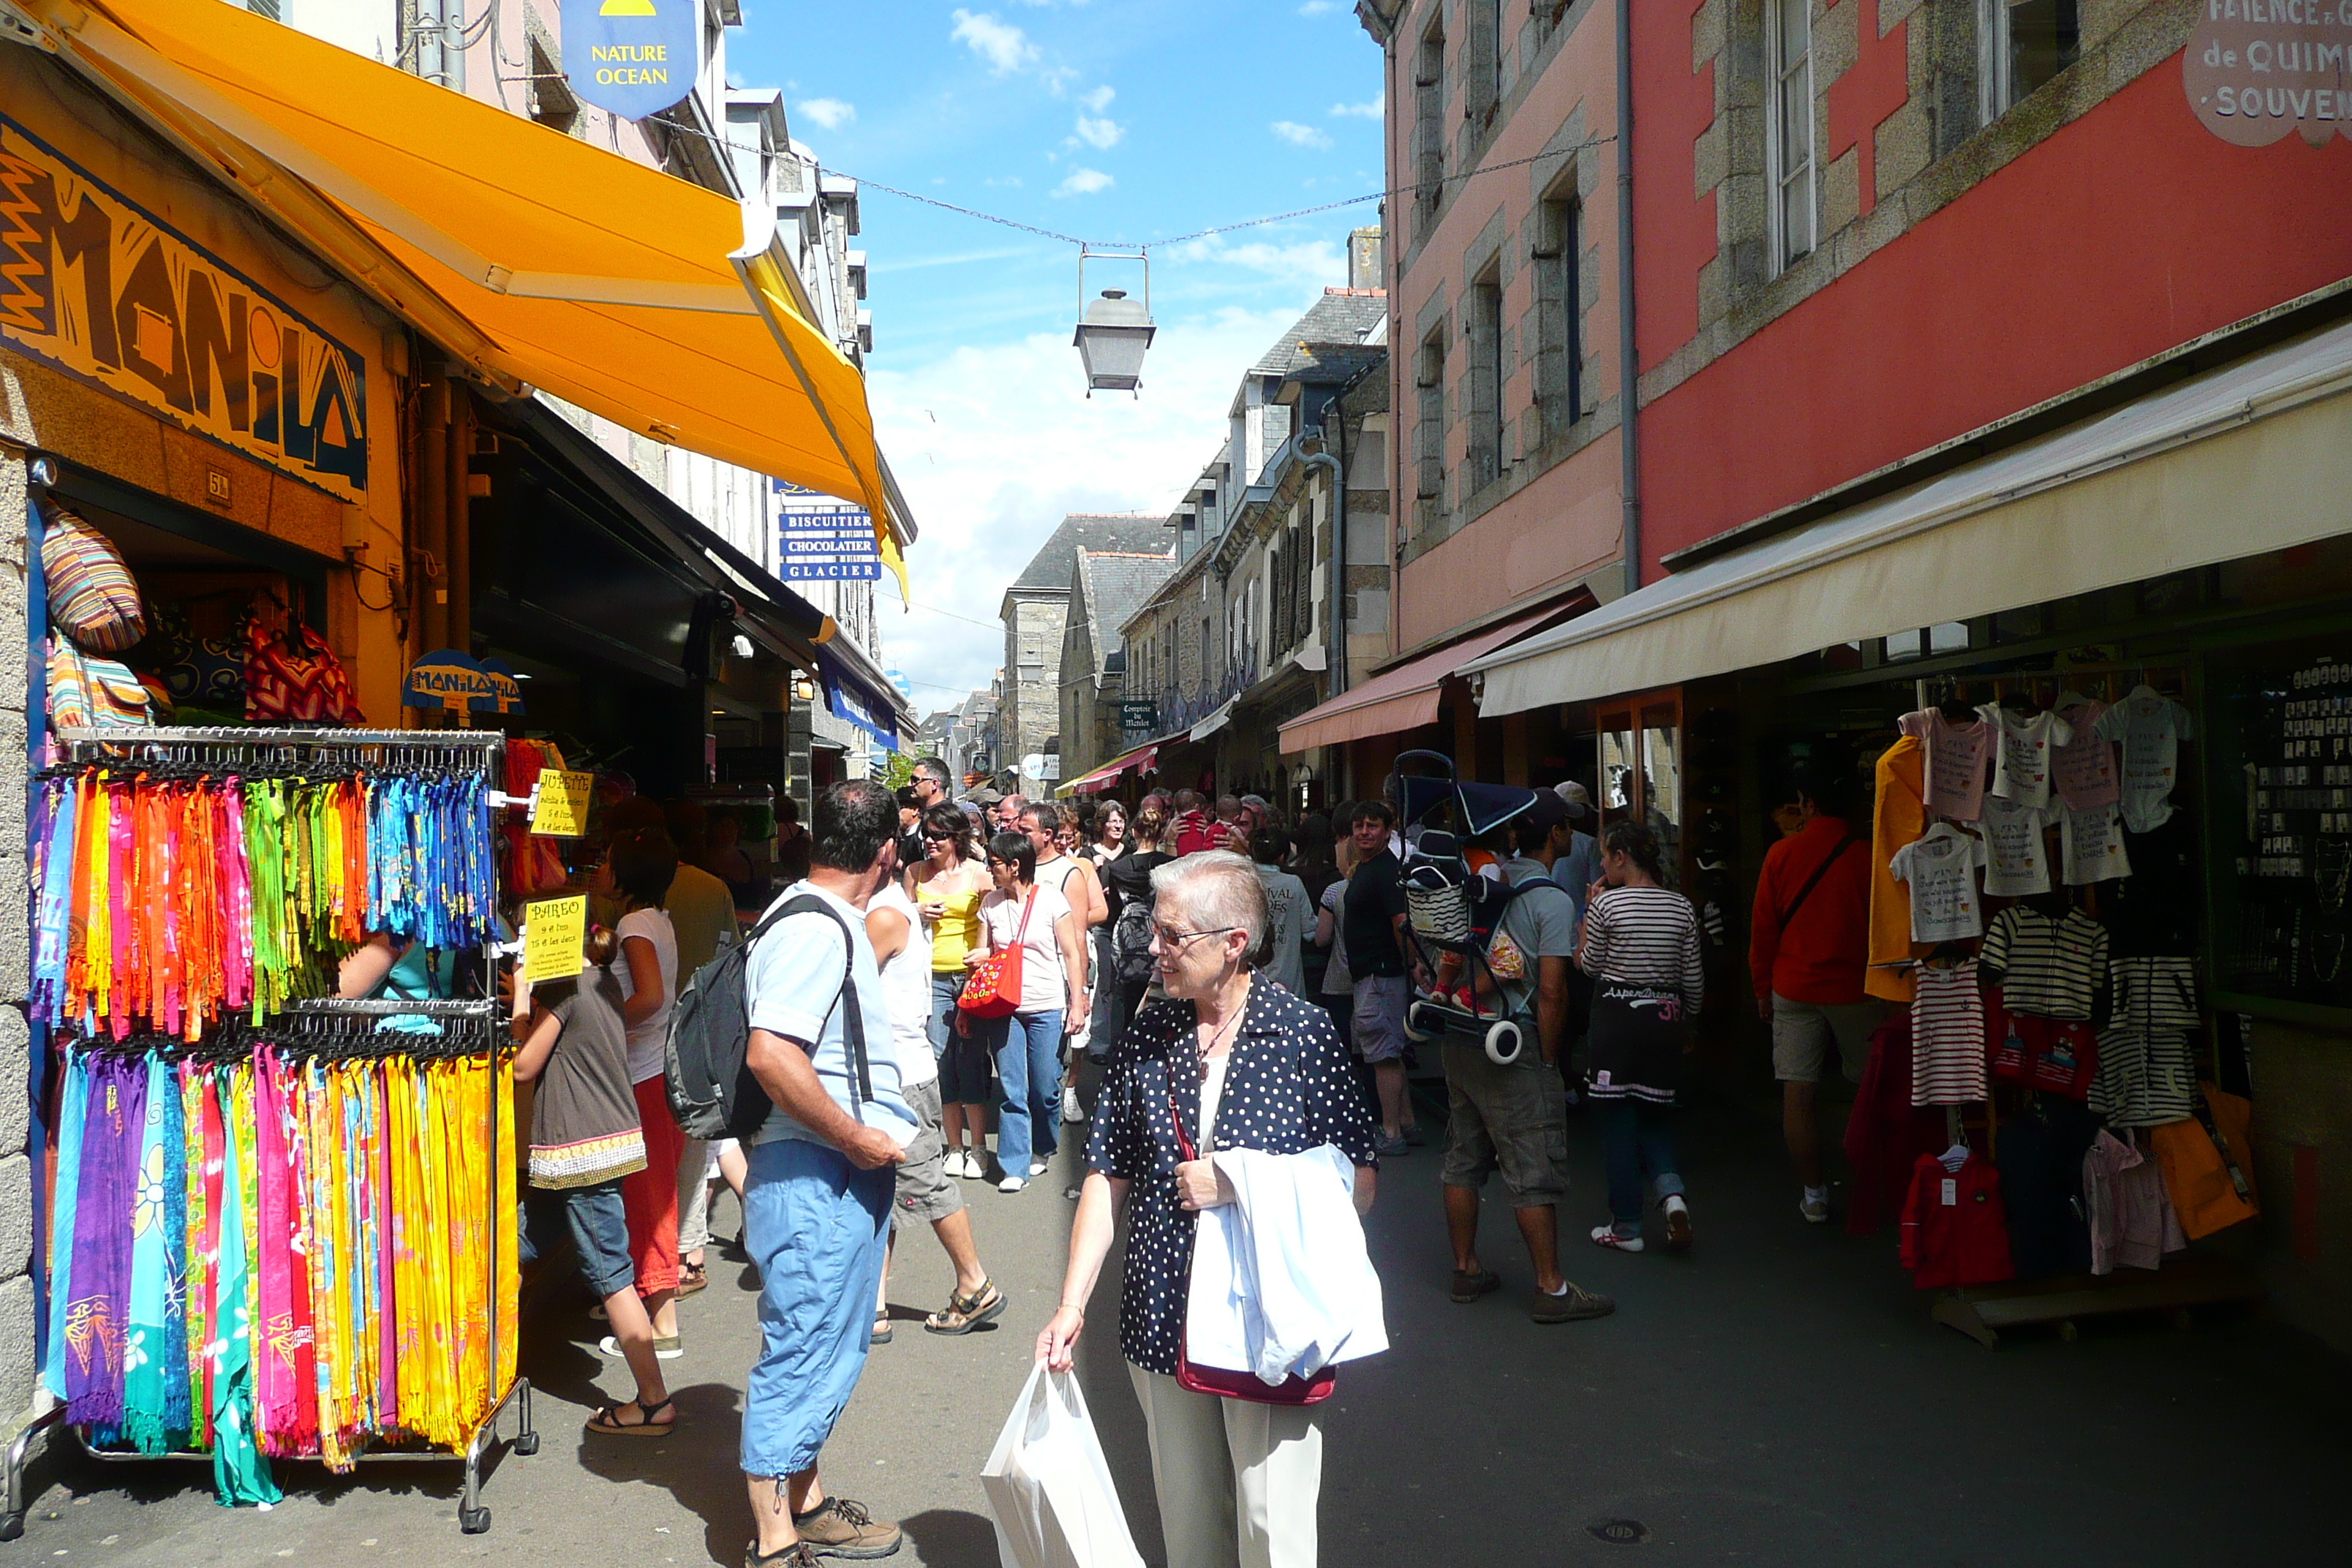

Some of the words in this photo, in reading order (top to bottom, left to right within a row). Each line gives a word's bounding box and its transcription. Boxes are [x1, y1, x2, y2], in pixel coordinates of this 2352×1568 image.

[592, 45, 667, 61] NATURE
[2204, 39, 2237, 68] de
[2247, 40, 2352, 73] QUIM
[595, 68, 668, 85] OCEAN
[788, 516, 872, 527] BISCUITIER
[788, 541, 872, 551] CHOCOLATIER
[789, 565, 873, 577] GLACIER
[540, 774, 589, 791] JUPETTE
[531, 901, 579, 920] PAREO
[541, 926, 546, 934] 9
[531, 939, 540, 949] 15
[549, 937, 559, 946] les
